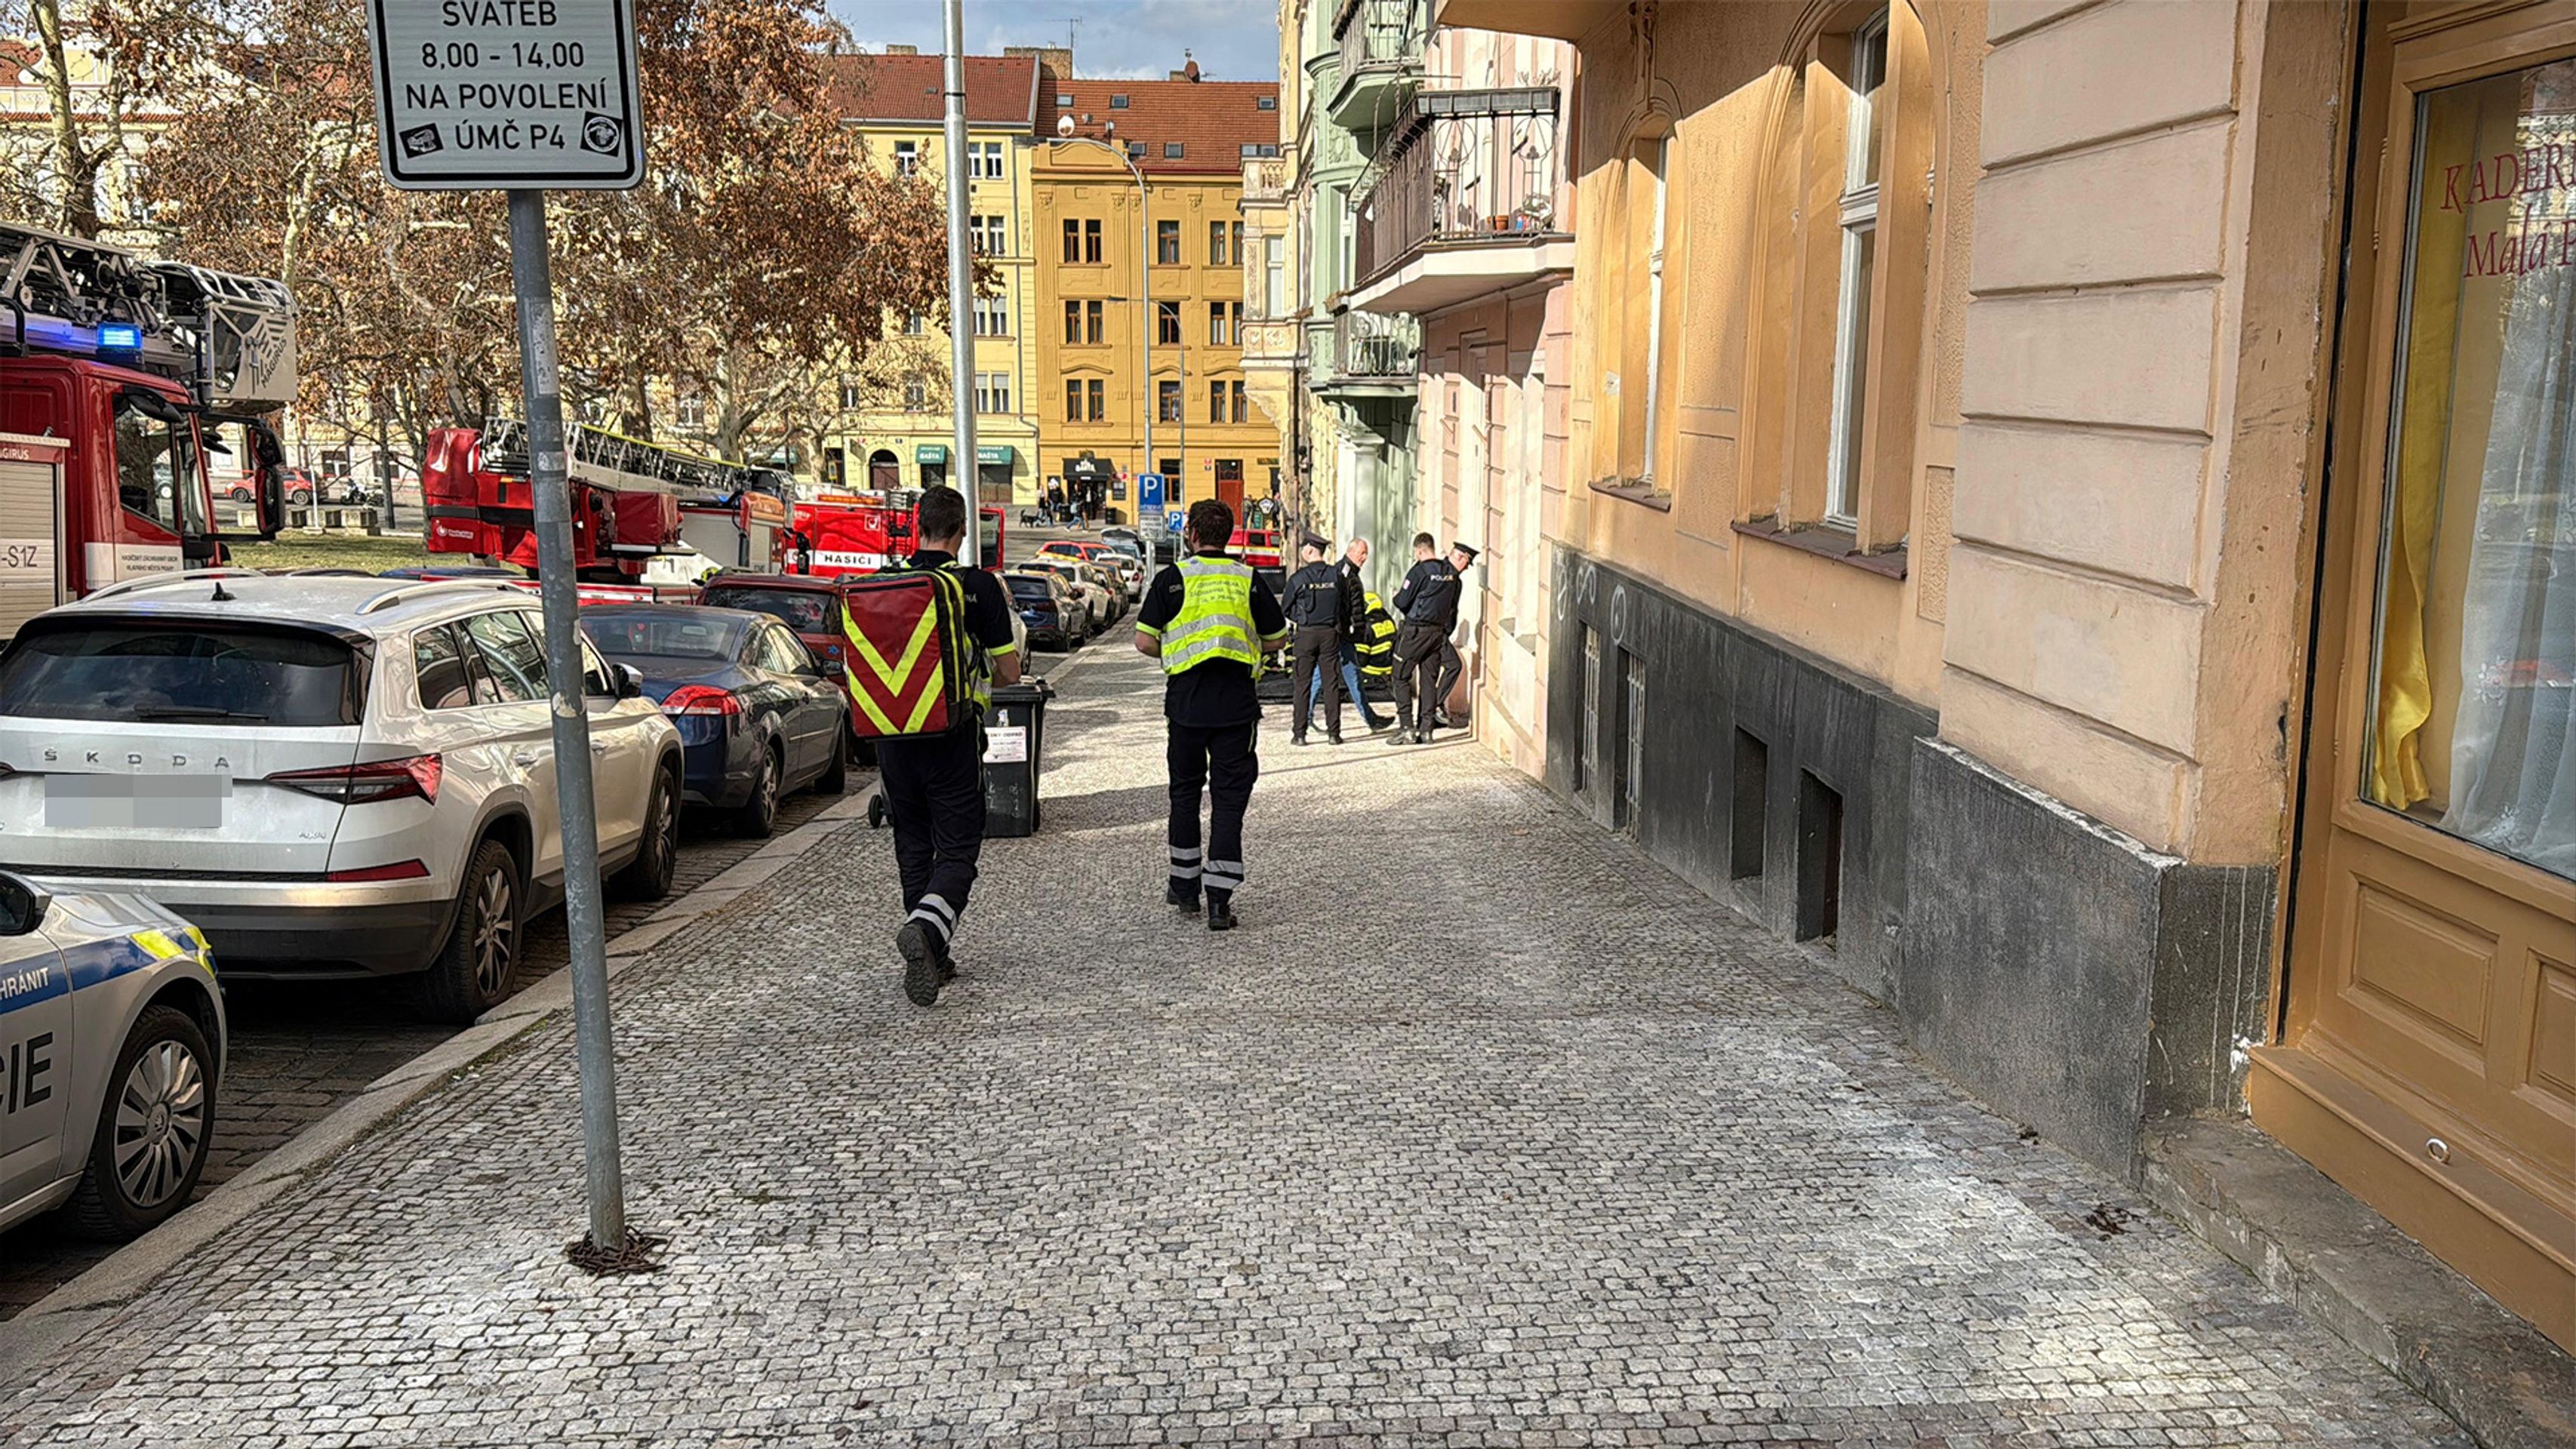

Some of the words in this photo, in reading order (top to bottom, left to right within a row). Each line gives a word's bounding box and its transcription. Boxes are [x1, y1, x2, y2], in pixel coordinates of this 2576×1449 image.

[442, 1, 557, 26] SVATEB
[422, 42, 479, 69] 8,00
[512, 42, 584, 69] 14,00
[406, 84, 449, 109] NA
[459, 78, 607, 109] POVOLENÍ
[455, 119, 520, 149] ÚMČ
[530, 125, 565, 149] P4
[2464, 204, 2551, 278] Malá
[260, 338, 287, 389] MAGIRUS
[0, 448, 29, 460] GIRUS
[1144, 476, 1158, 498] P
[1171, 513, 1180, 527] P
[824, 554, 872, 565] HASIČI
[44, 747, 230, 768] ŠKODA
[0, 1032, 53, 1115] IE
